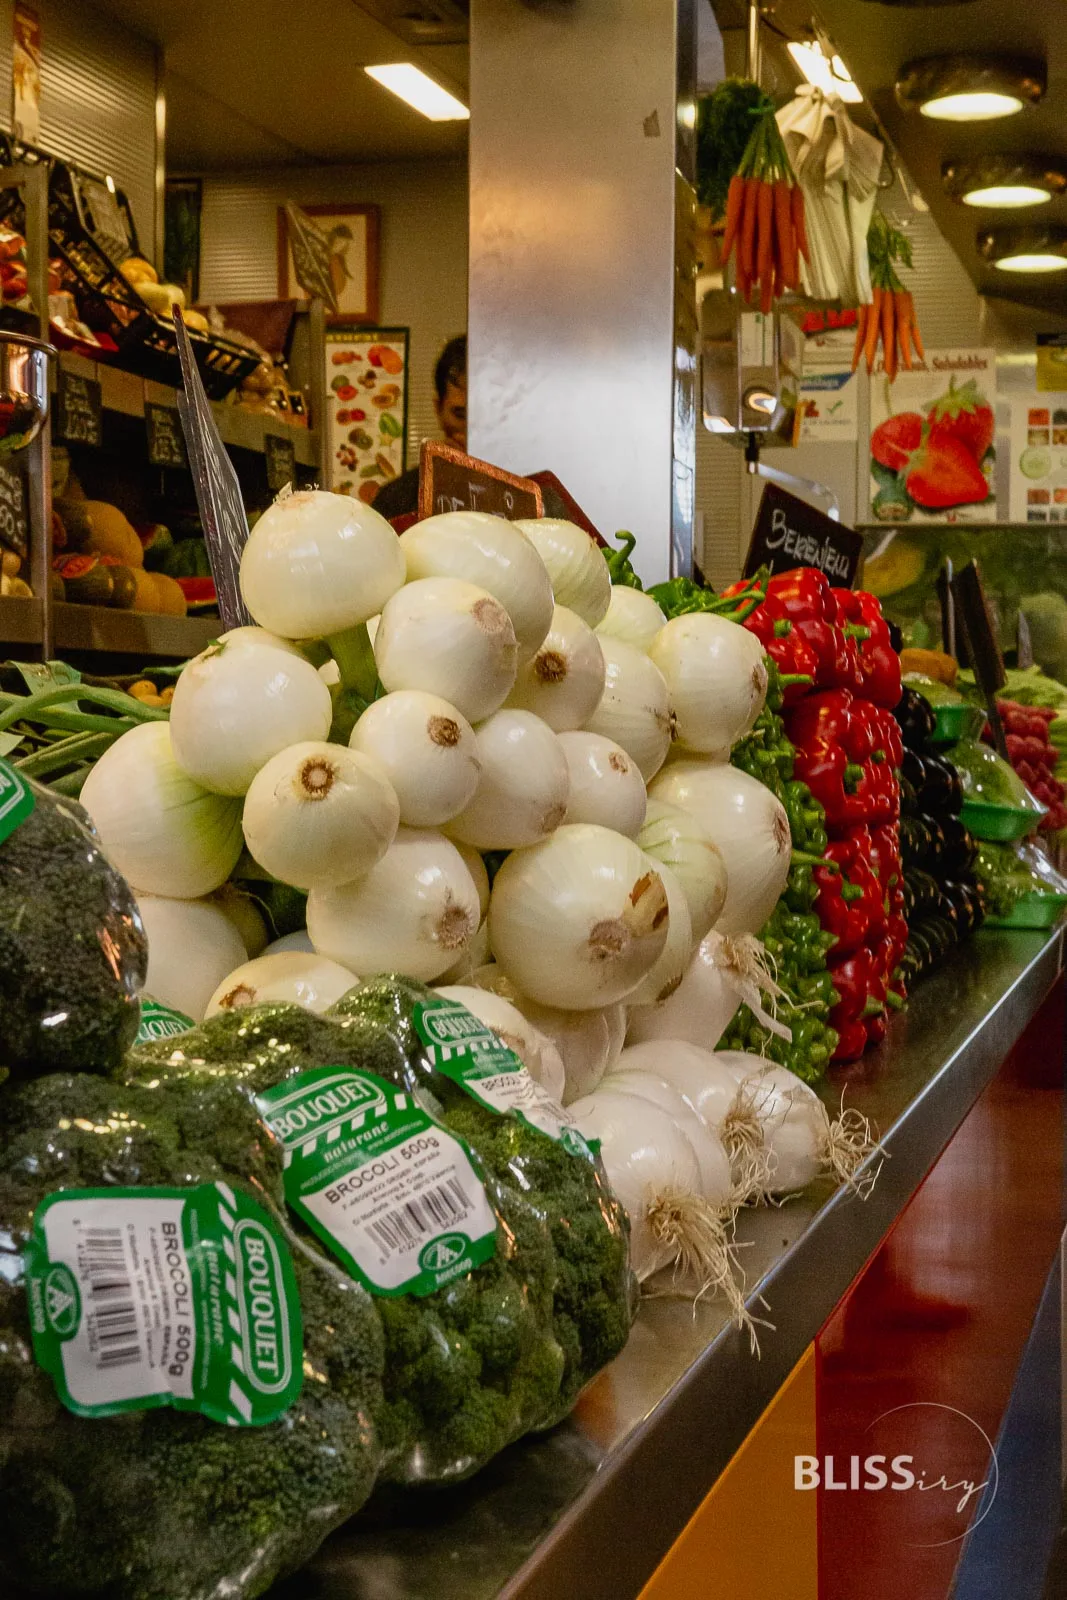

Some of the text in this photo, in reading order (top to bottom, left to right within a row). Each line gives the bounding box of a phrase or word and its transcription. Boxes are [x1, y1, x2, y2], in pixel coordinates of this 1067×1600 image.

[433, 1017, 486, 1038] BOUQUET
[272, 1079, 372, 1141] BOUQUET
[322, 1120, 390, 1164] naturane
[324, 1154, 400, 1205] BROCOLI
[400, 1135, 440, 1162] 500g
[161, 1221, 189, 1377] BROCOLI 500g
[245, 1235, 280, 1377] BOUQUET
